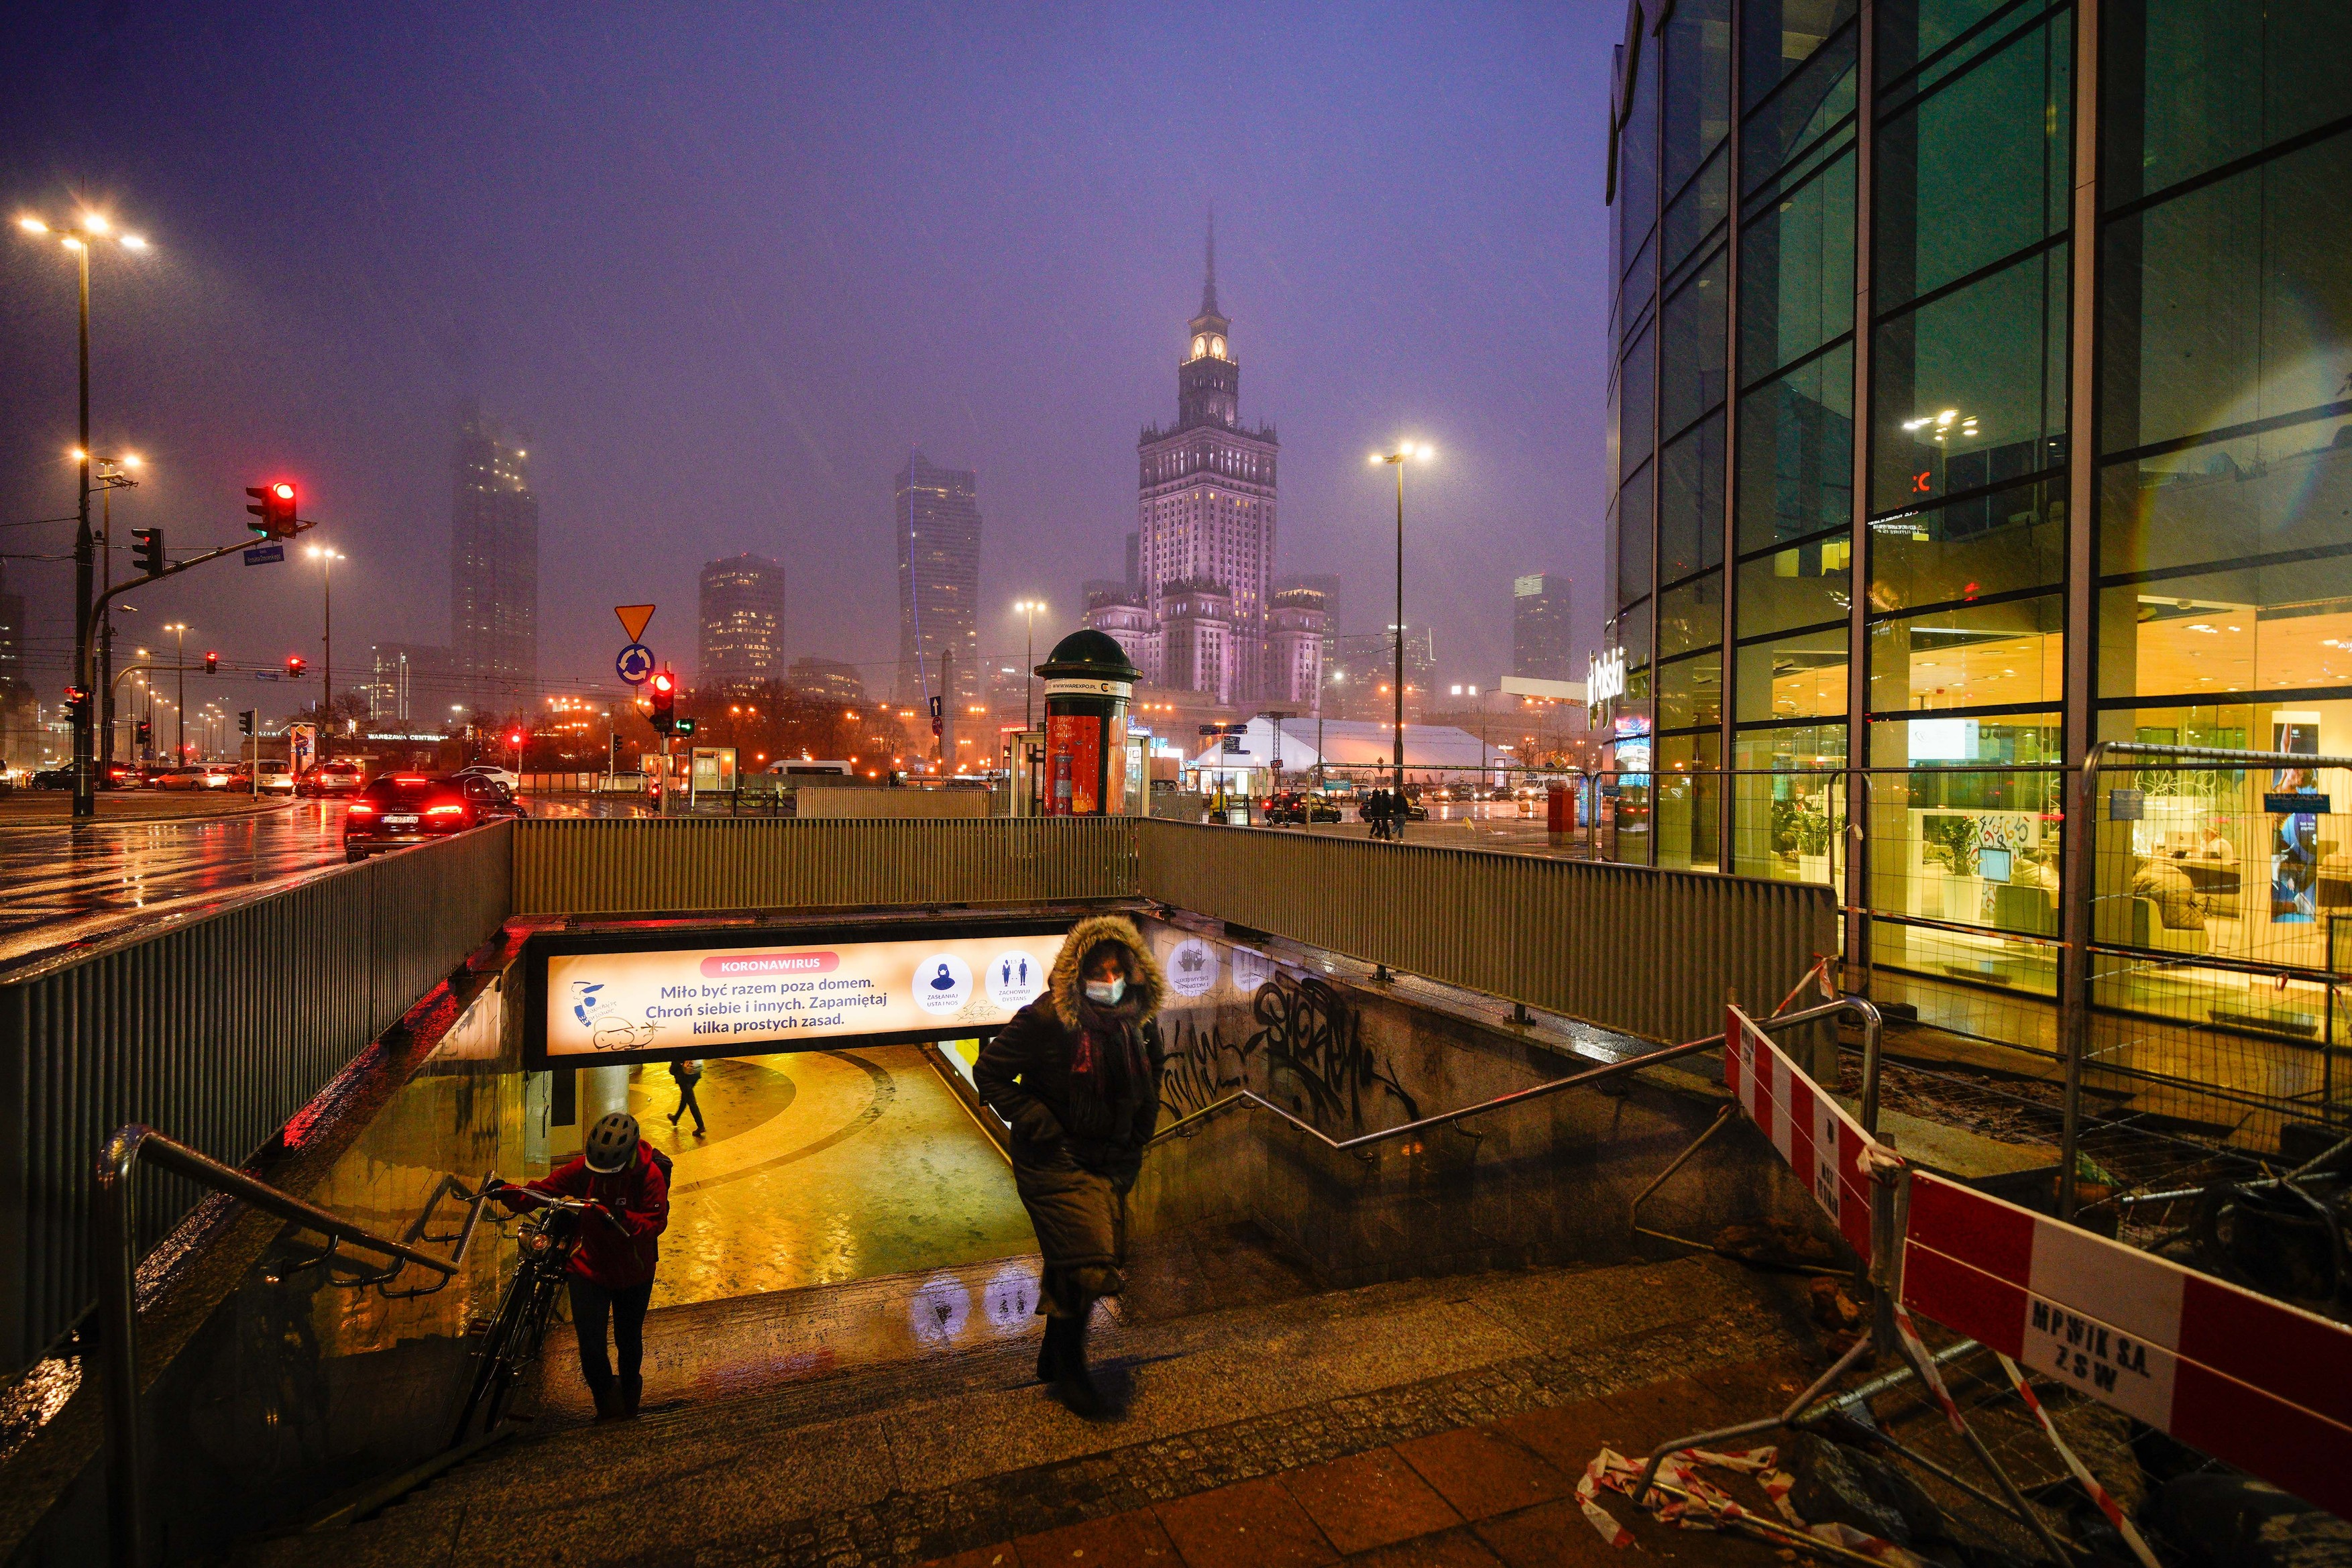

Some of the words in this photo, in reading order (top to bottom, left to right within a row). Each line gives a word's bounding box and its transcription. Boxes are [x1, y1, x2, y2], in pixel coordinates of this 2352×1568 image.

[721, 958, 820, 972] KORONAWIRUS
[661, 986, 697, 999] Miło
[702, 983, 727, 999] być
[732, 984, 777, 997] razem
[781, 981, 814, 997] poza
[818, 976, 875, 991] domem.
[646, 1005, 693, 1019] Chroń
[697, 1000, 741, 1015] siebie
[745, 1000, 749, 1013] i
[754, 997, 805, 1014] innych.
[809, 991, 887, 1009] Zapamiętaj
[693, 1020, 729, 1035] kilka
[734, 1016, 797, 1036] prostych
[801, 1013, 845, 1027] zasad.
